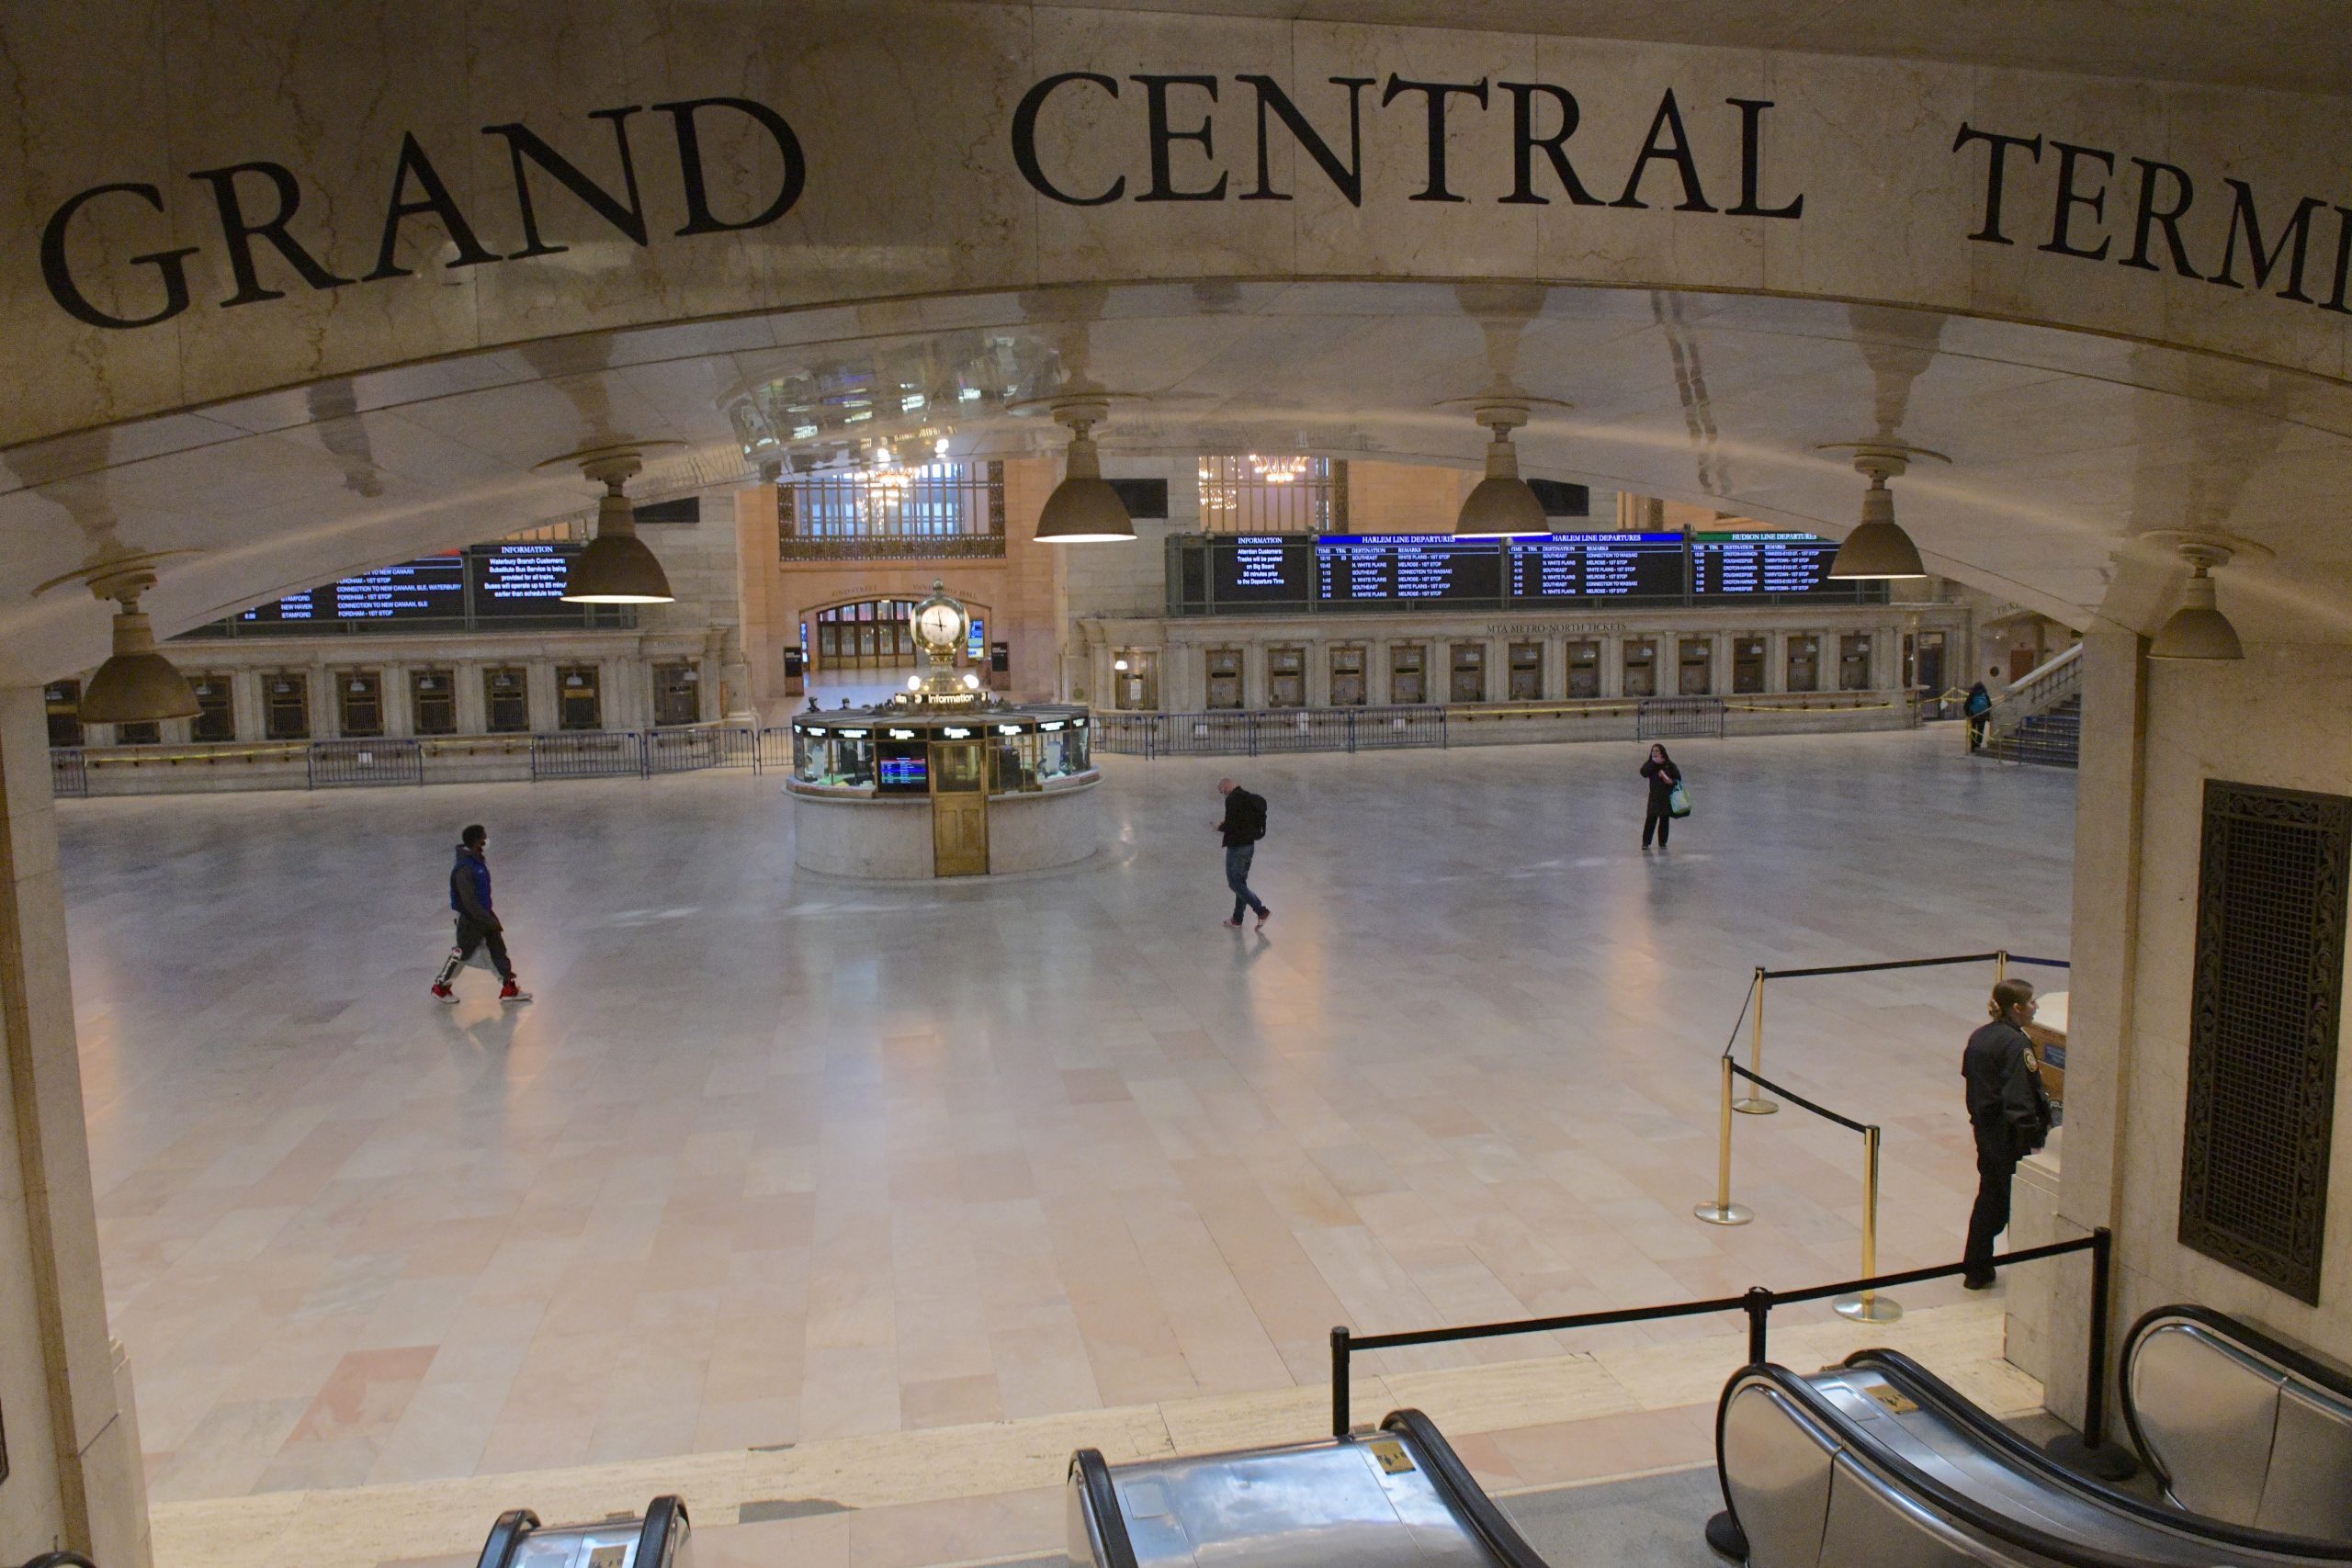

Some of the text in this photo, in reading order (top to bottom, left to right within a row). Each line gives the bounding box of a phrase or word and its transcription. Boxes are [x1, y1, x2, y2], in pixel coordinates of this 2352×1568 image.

[40, 97, 806, 330] GRAND
[1011, 70, 1804, 219] CENTRAL
[1487, 625, 1507, 633] MTA
[1587, 622, 1627, 632] TICKETS
[928, 694, 974, 704] Information
